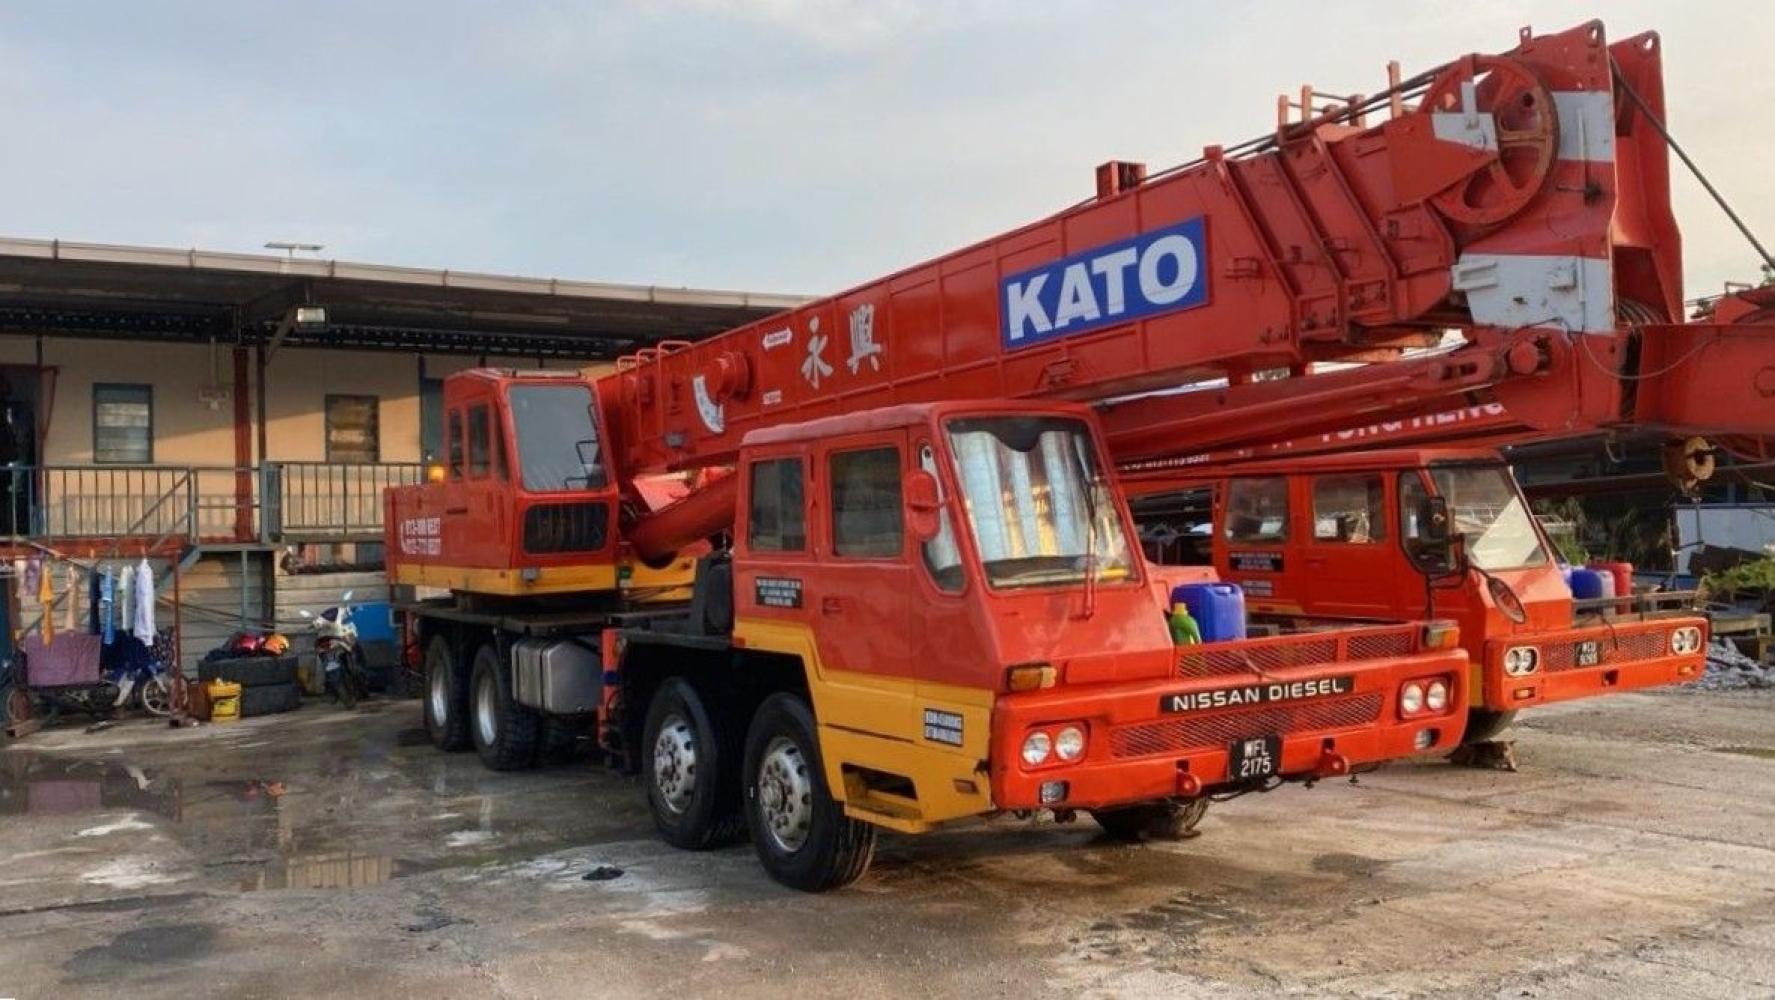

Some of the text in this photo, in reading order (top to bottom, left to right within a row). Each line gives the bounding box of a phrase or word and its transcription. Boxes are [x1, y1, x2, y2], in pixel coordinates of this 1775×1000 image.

[1007, 234, 1198, 341] KATO
[1173, 678, 1345, 711] NISSAN DIESEL
[1244, 738, 1269, 757] WFL
[1241, 756, 1271, 777] 2175
